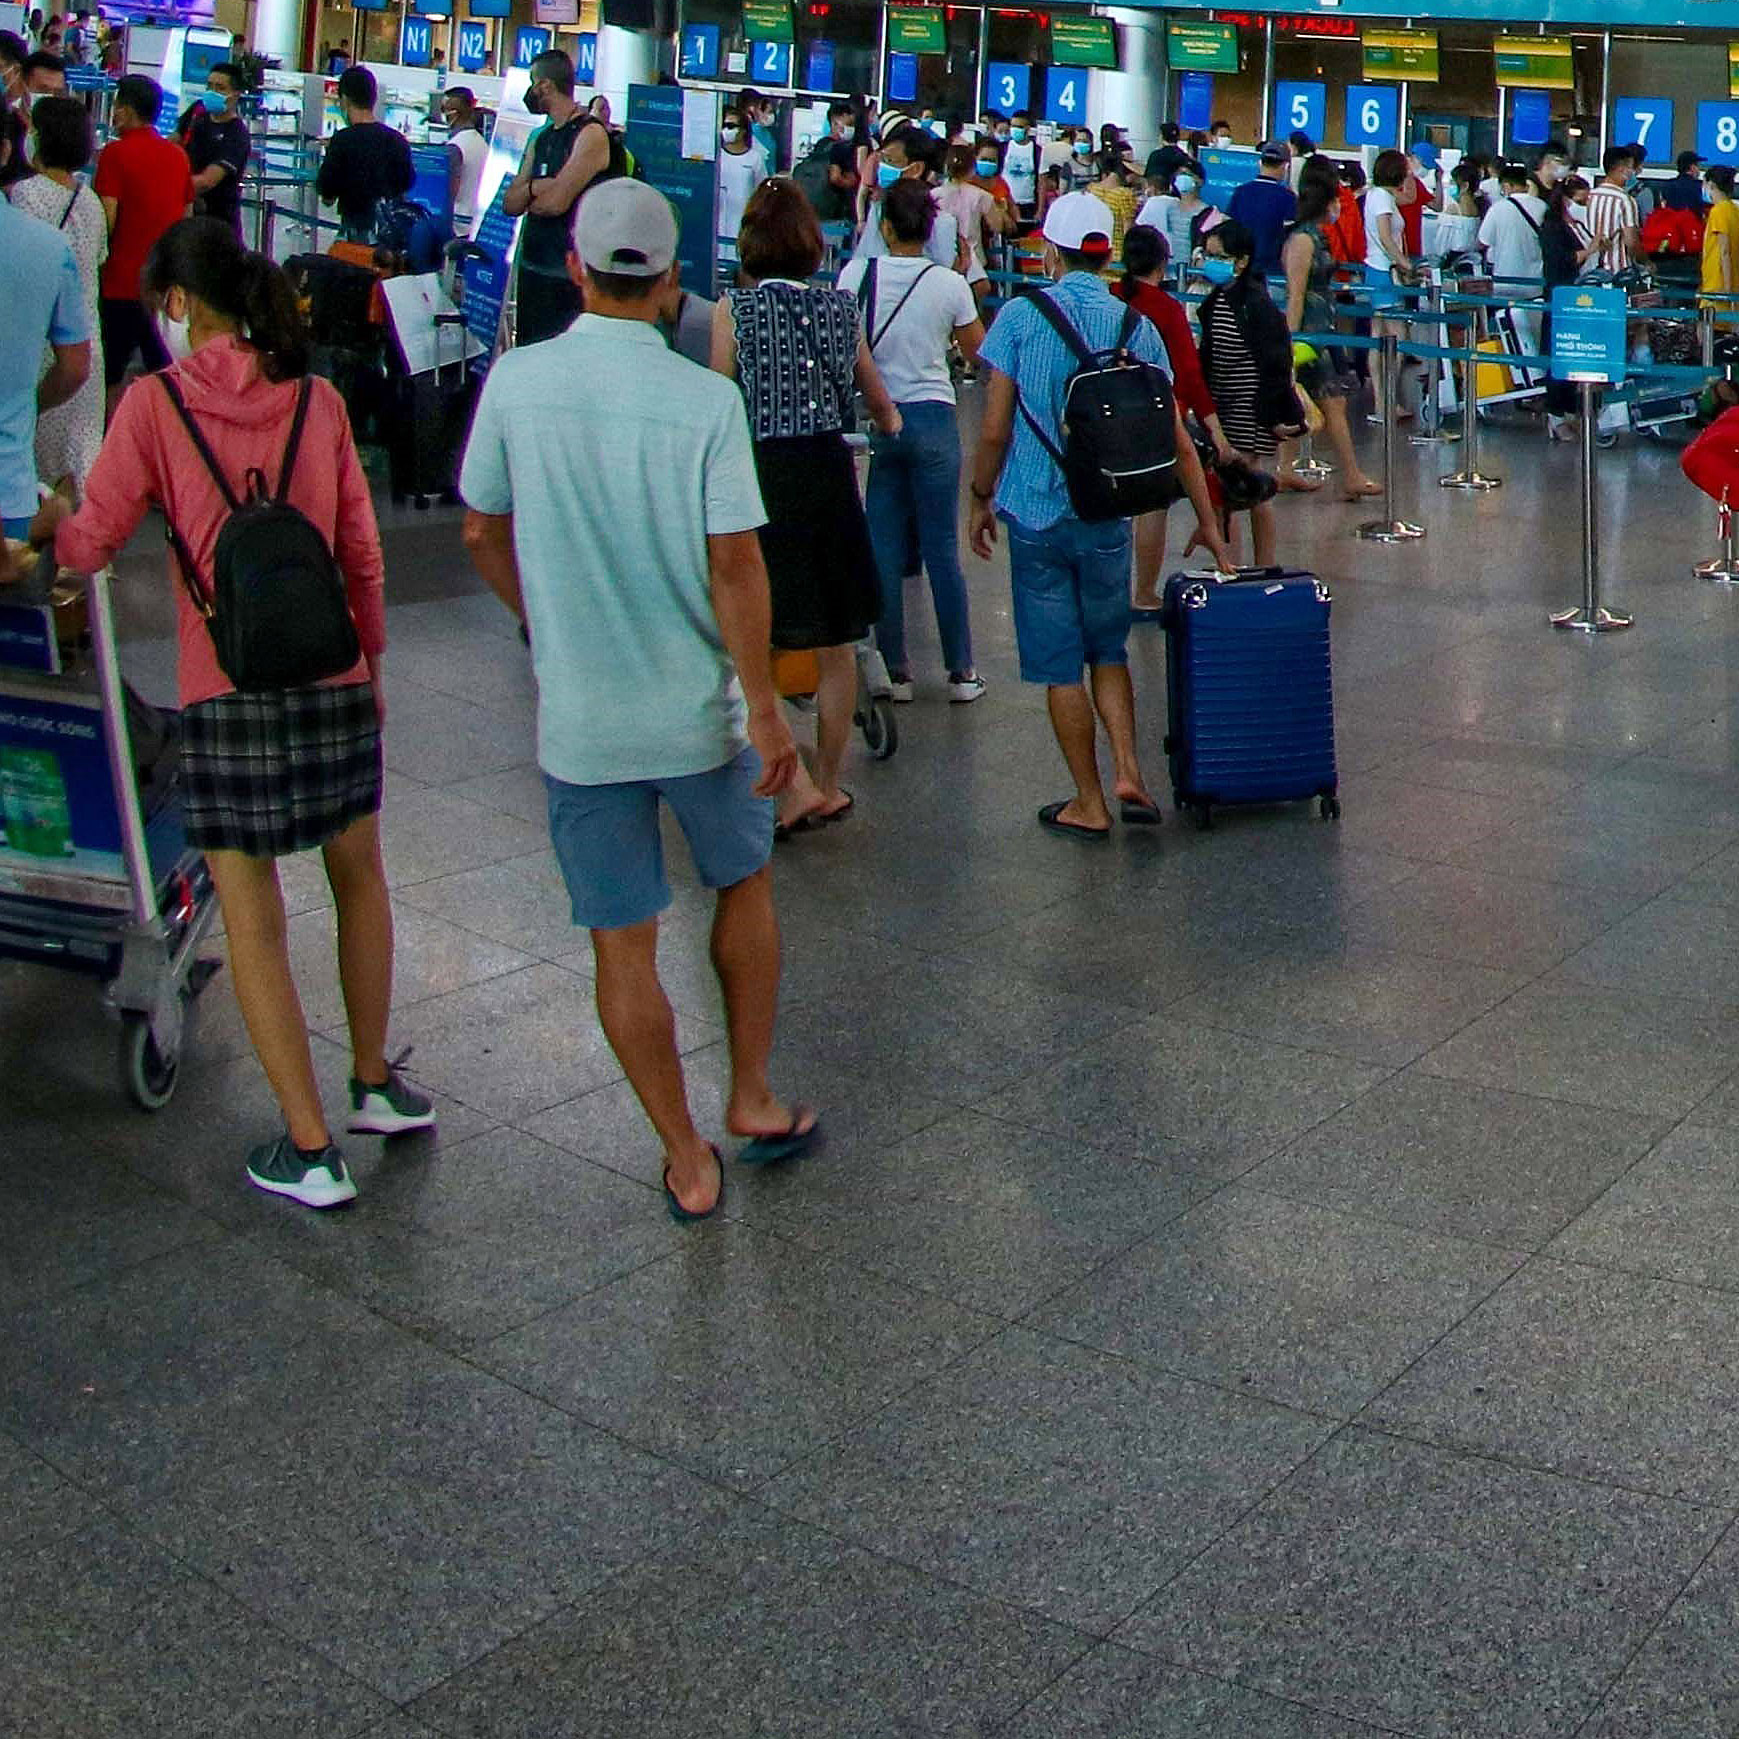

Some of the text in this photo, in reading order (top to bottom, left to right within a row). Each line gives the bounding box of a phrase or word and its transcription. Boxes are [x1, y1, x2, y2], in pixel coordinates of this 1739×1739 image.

[406, 27, 428, 53] N1
[460, 30, 484, 59] N2
[764, 43, 777, 71] 2
[1001, 75, 1016, 106] 3
[1058, 79, 1076, 112] 4
[1290, 94, 1309, 128] 5
[1361, 99, 1381, 134] 6
[1633, 113, 1656, 146] 7
[1715, 117, 1738, 153] 8
